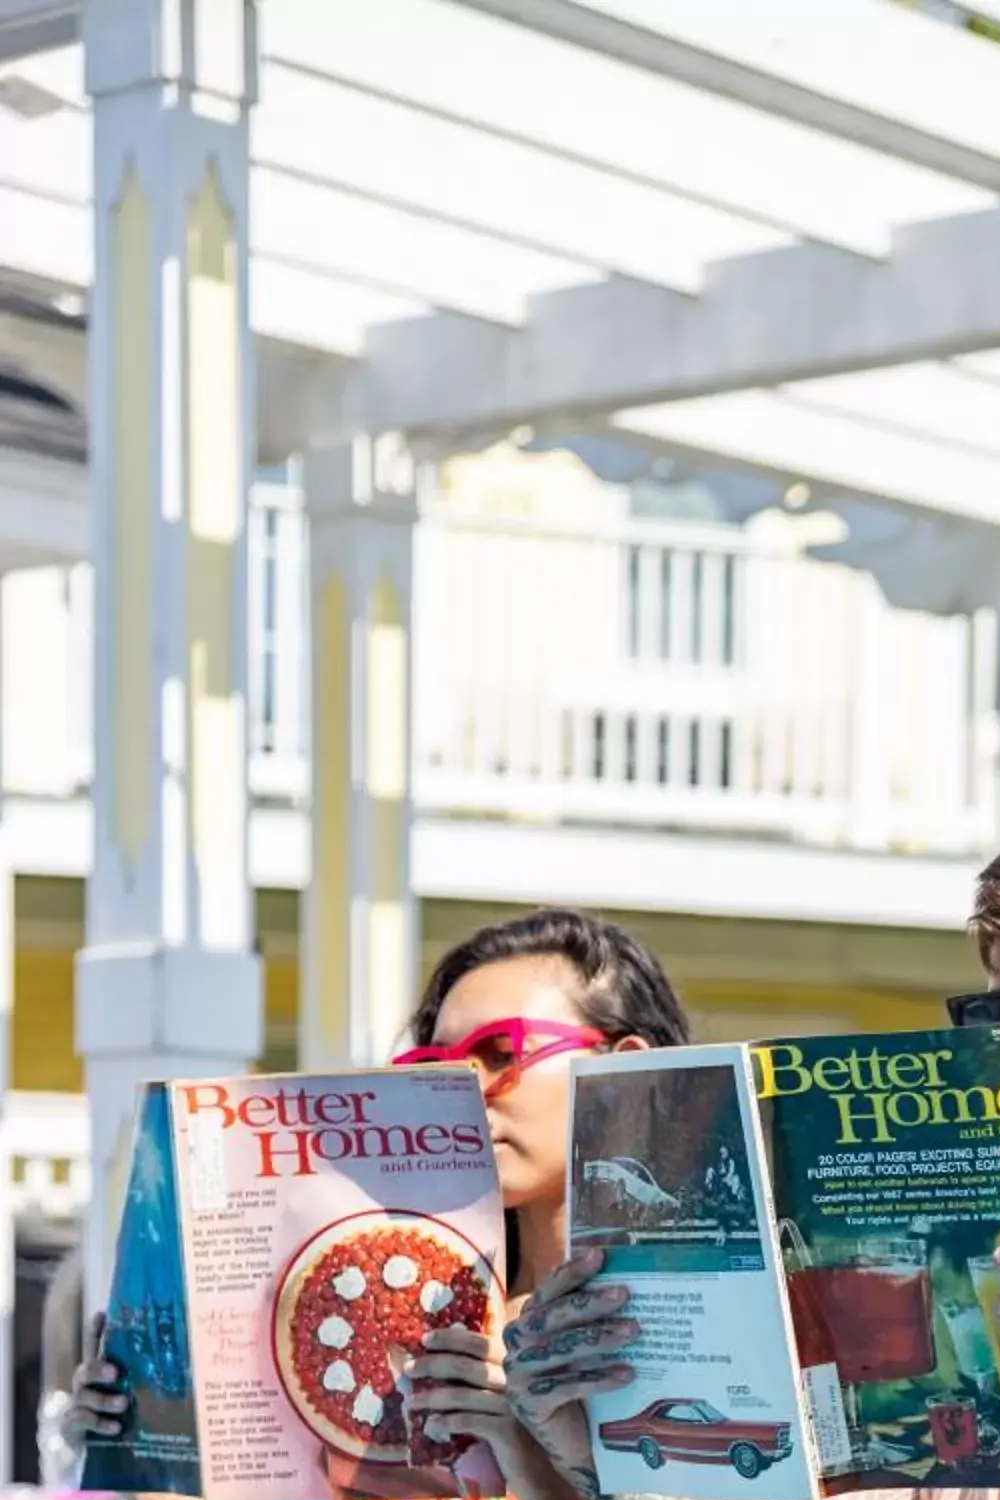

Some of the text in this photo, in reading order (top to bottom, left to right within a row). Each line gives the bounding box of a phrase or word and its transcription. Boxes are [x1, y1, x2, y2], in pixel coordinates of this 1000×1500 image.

[751, 1045, 952, 1098] Better
[182, 1085, 377, 1130] Better
[959, 1123, 994, 1139] and
[252, 1124, 485, 1178] Homes
[381, 1158, 412, 1175] and
[818, 1154, 835, 1166] 20
[836, 1152, 875, 1164] COLOR
[920, 1147, 975, 1162] EXCITING
